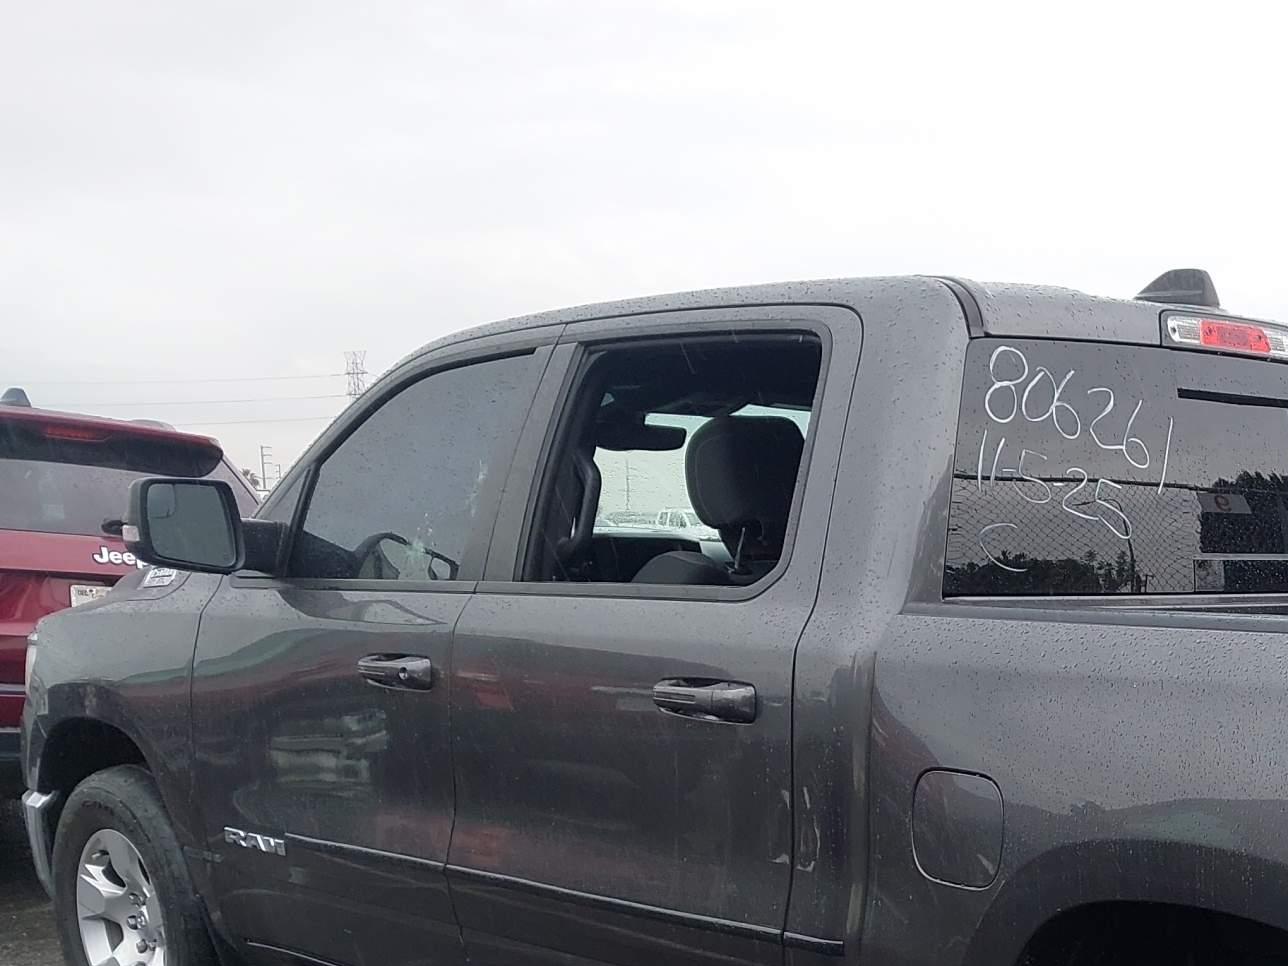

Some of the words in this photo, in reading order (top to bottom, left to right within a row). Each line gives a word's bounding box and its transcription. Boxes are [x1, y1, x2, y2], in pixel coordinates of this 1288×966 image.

[984, 345, 1174, 495] 806261
[977, 428, 1132, 539] 11-5-25
[223, 826, 286, 857] RAM
